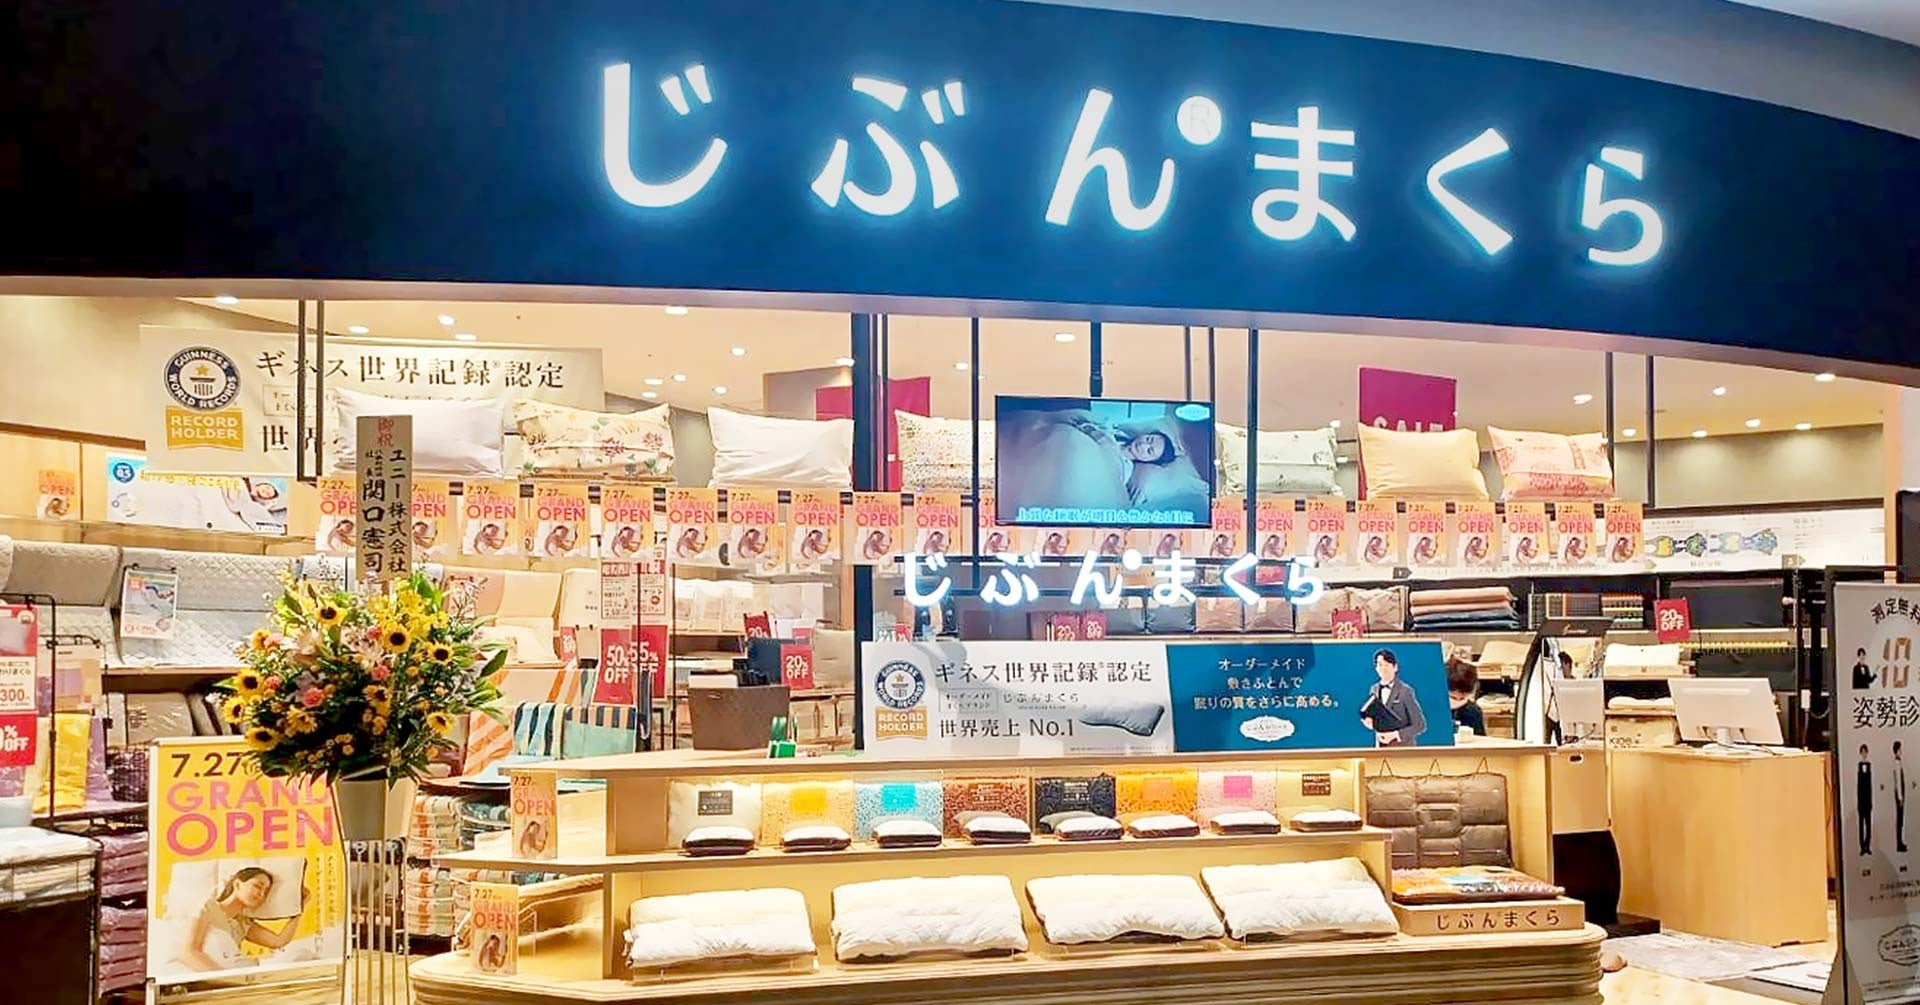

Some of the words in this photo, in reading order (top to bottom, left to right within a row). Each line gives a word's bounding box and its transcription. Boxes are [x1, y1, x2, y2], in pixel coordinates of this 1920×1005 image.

[175, 350, 230, 368] GUINNESS
[168, 375, 197, 406] WORLD
[200, 376, 238, 408] RECORDS
[171, 415, 239, 427] RECORD
[171, 428, 240, 441] HOLDER
[320, 501, 357, 515] OPE
[412, 503, 447, 517] PEN
[466, 504, 517, 518] OPEN
[537, 507, 586, 520] OPEN
[603, 508, 651, 522] OPEN
[669, 509, 715, 523] OPEN
[731, 511, 775, 524] OPEN
[794, 512, 838, 525] OPEN
[856, 513, 899, 526] OPEN
[917, 515, 958, 528] OPEN
[1215, 520, 1241, 531] PEN
[1257, 520, 1294, 531] OPEN
[1308, 519, 1345, 531] OPEN
[1358, 520, 1395, 532] OPEN
[1408, 521, 1444, 533] OPEN
[1458, 521, 1494, 533] OPEN
[1508, 521, 1544, 534] OPEN
[1558, 521, 1593, 534] OPEN
[1606, 521, 1641, 534] OPEN
[1661, 620, 1685, 631] OFF
[786, 655, 809, 669] 20%
[1218, 658, 1305, 671] オーダーメイド
[604, 667, 629, 684] OFF
[786, 669, 809, 679] OFF
[878, 712, 925, 722] RECORD
[878, 722, 925, 732] HOLDER
[939, 718, 1021, 738] 世界売上
[1029, 718, 1074, 737] No.1
[4, 737, 29, 752] OFF
[170, 751, 242, 779] 7.27
[166, 776, 331, 813] GRAND
[514, 799, 556, 816] OPEN
[166, 806, 334, 857] OPEN
[473, 912, 516, 930] OPEN
[1436, 909, 1560, 931] じぶんまくら
